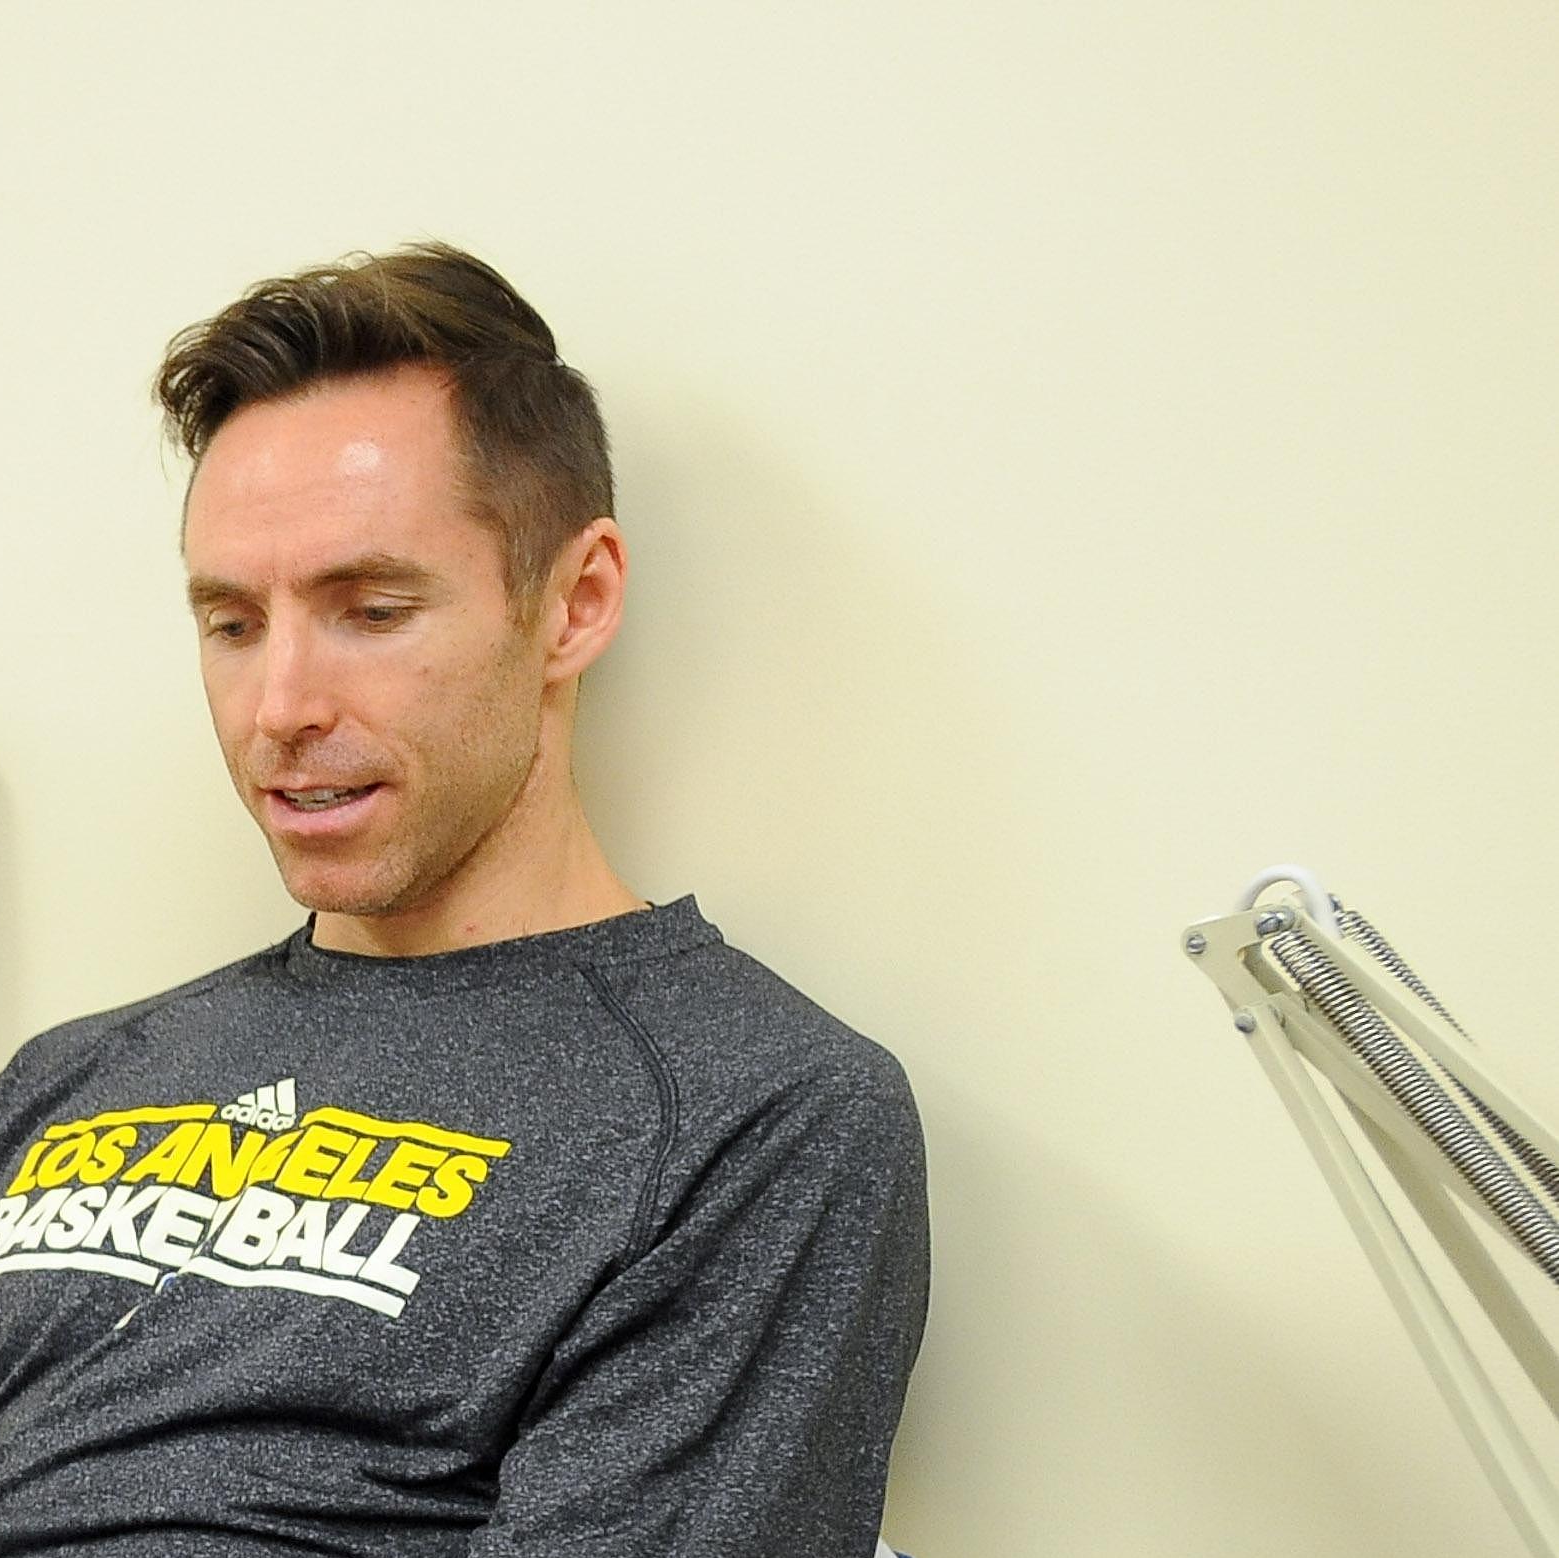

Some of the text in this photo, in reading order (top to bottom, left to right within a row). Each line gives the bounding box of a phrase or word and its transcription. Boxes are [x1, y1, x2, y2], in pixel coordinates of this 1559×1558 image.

[220, 1103, 297, 1131] adidas
[6, 1121, 489, 1218] LOS ANGELES
